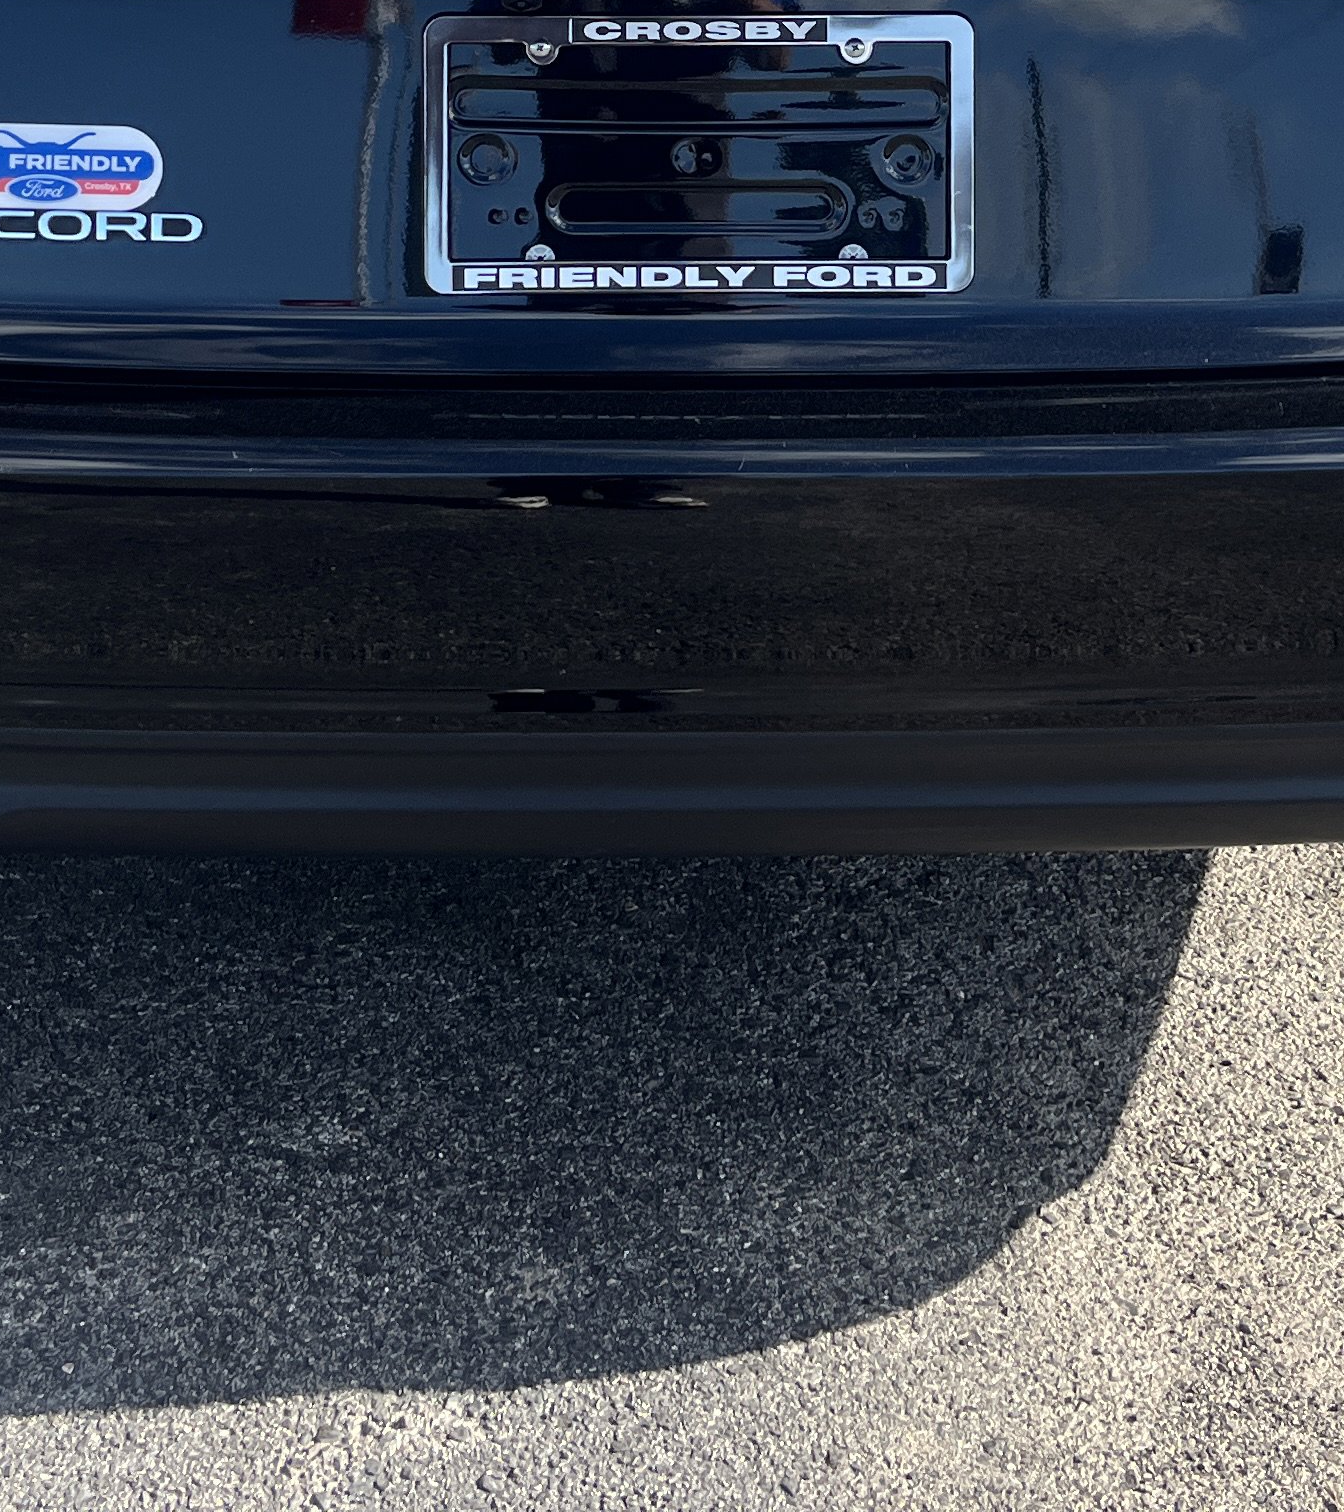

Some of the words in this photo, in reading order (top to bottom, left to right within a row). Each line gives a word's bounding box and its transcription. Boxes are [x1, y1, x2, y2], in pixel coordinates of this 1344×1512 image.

[583, 20, 817, 41] CROSBY
[9, 153, 142, 173] FRIENDLY
[21, 179, 65, 198] Ford
[119, 183, 132, 192] TX
[463, 266, 756, 289] FRIENDLY
[773, 265, 937, 288] FORD
